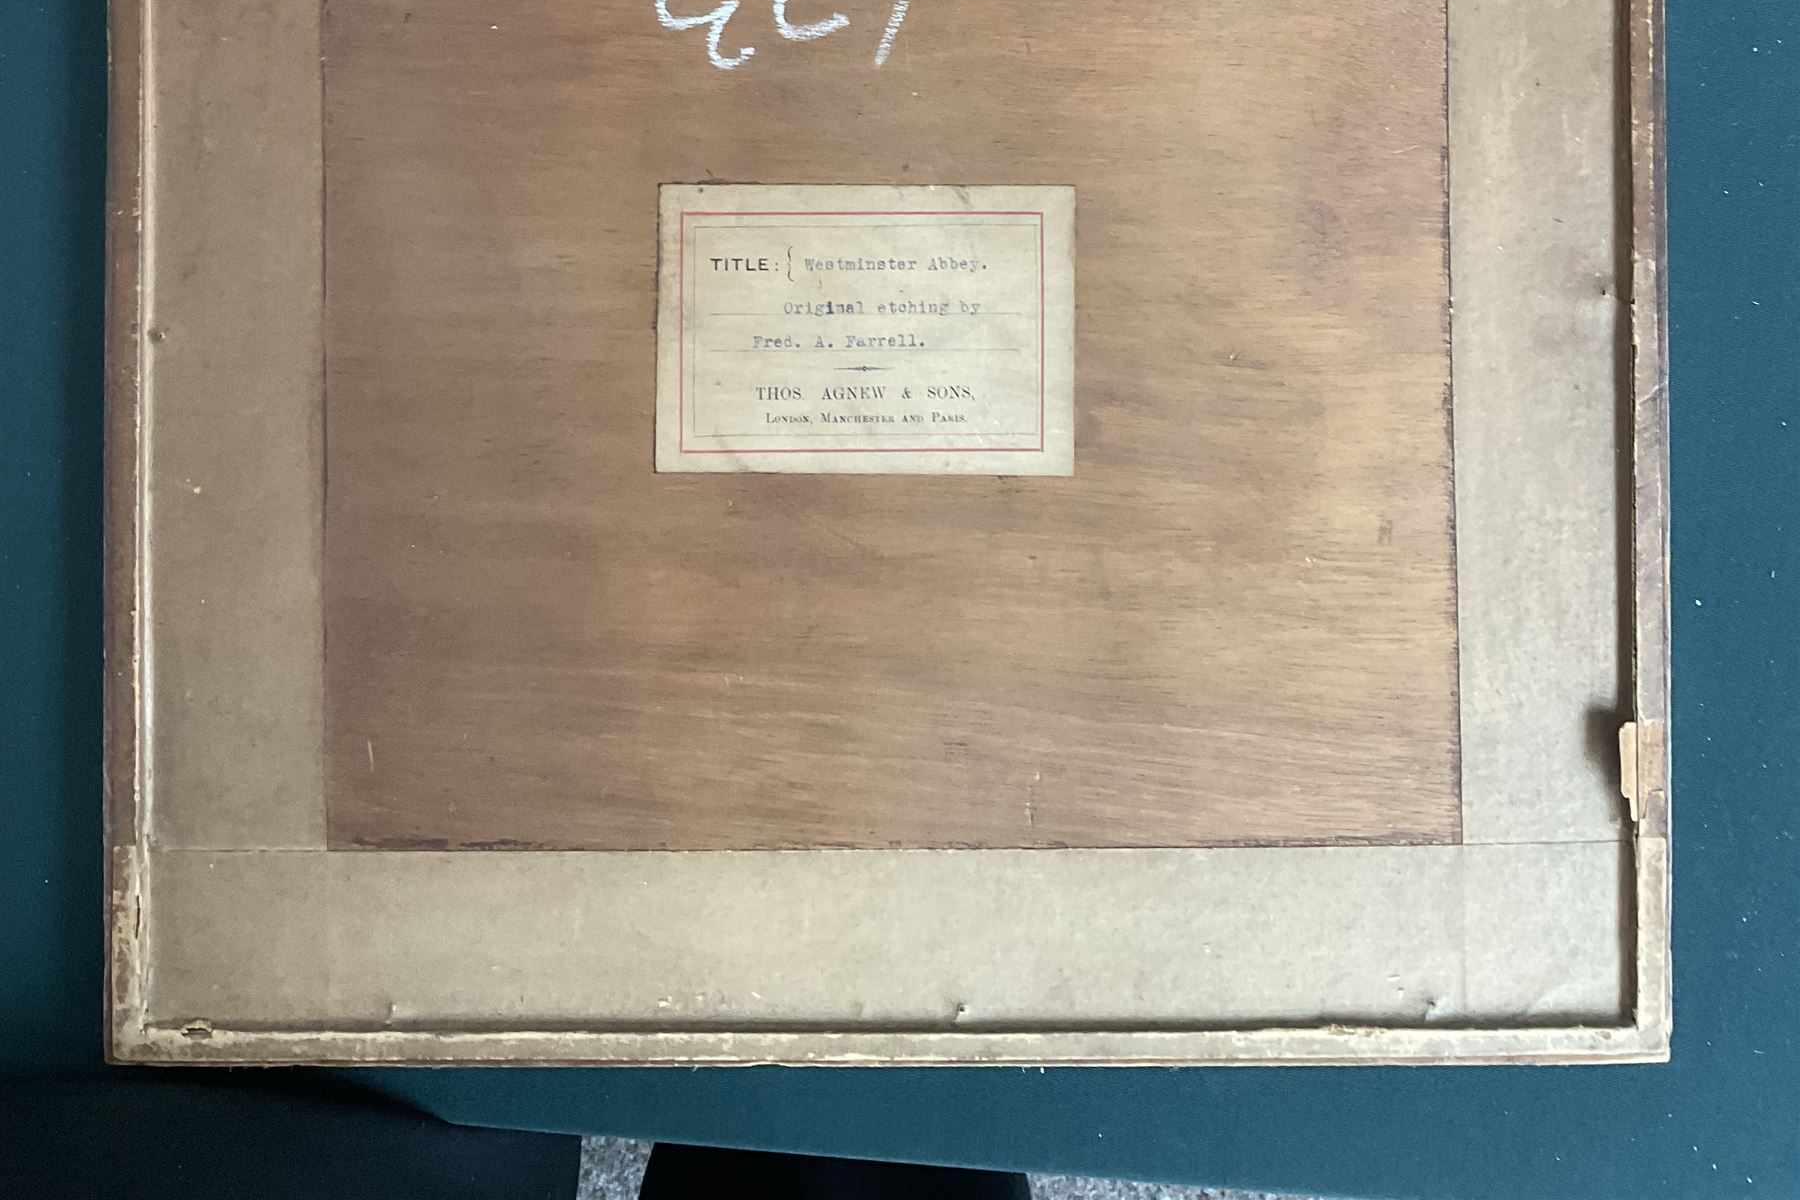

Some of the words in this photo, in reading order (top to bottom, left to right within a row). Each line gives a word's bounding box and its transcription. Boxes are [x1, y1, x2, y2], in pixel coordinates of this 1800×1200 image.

[804, 257, 917, 272] Westminster
[927, 256, 988, 273] Abbey.
[783, 301, 865, 317] Original
[877, 300, 950, 316] etching
[959, 300, 981, 316] by
[752, 335, 801, 349] Fred.
[814, 335, 834, 349] A.
[845, 333, 925, 349] Farrell.
[821, 386, 887, 401] AGNEW
[901, 388, 913, 400] &
[820, 412, 895, 424] MANCHESTER
[901, 414, 924, 423] AND
